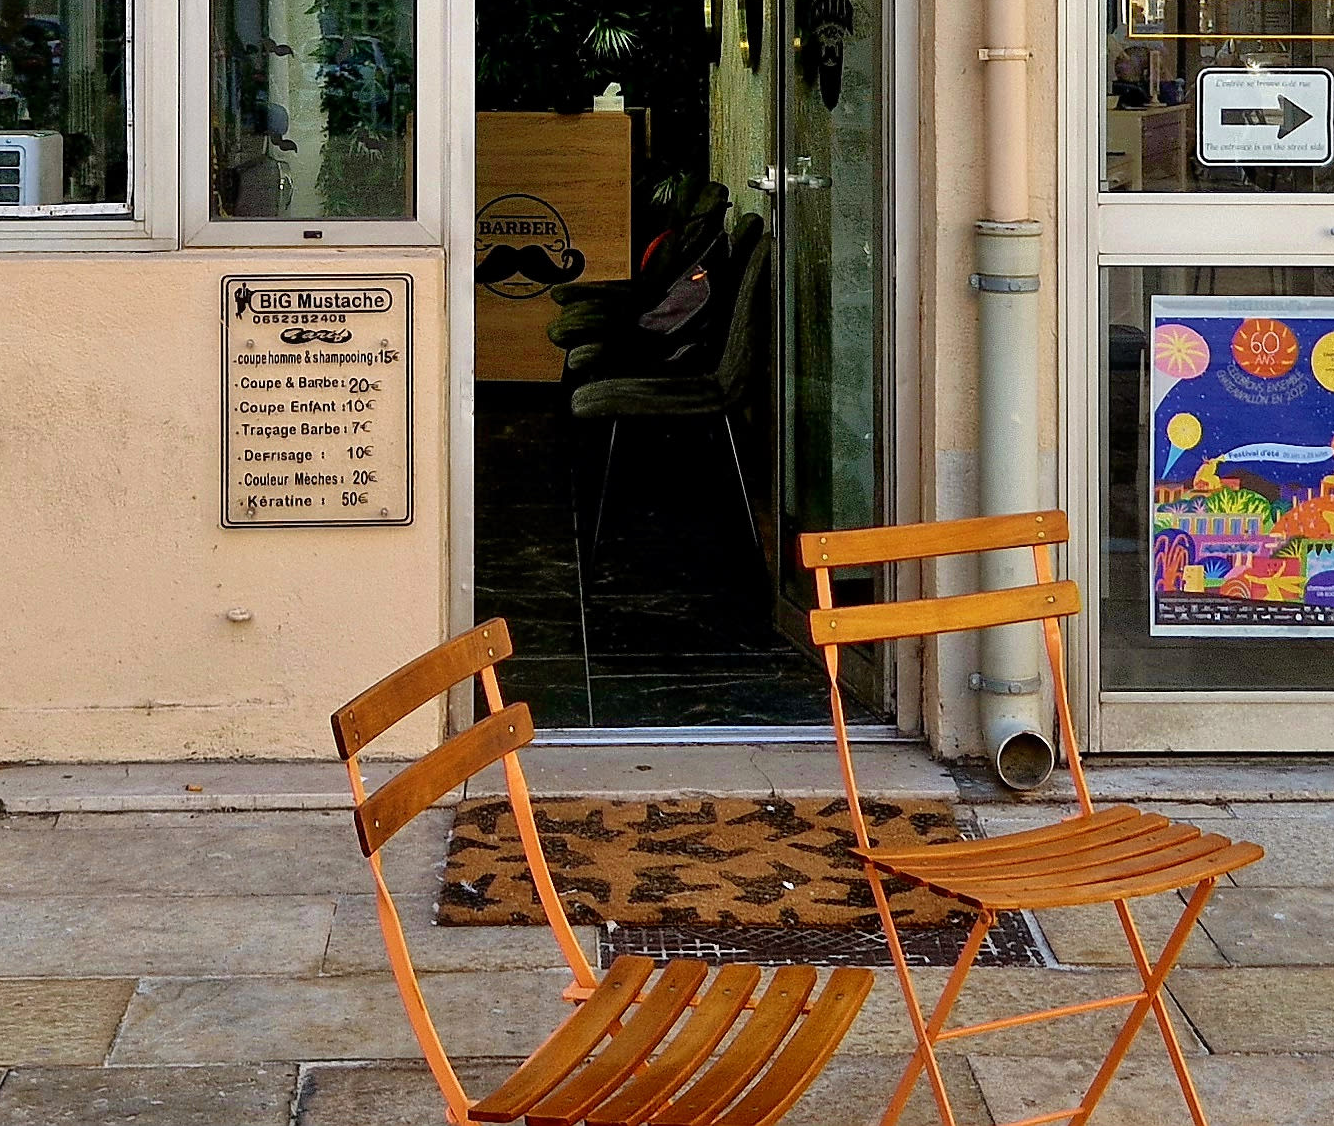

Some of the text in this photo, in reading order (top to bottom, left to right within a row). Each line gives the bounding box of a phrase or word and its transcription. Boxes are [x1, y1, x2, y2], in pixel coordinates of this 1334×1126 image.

[478, 221, 558, 236] BARBER
[260, 292, 385, 309] BiG Mustache
[252, 314, 346, 325] 0652352408
[1251, 331, 1280, 354] 60
[268, 351, 302, 364] homme
[1255, 354, 1275, 365] ANS
[285, 377, 295, 388] &
[241, 423, 297, 439] Traçage
[244, 473, 289, 486] Couleur
